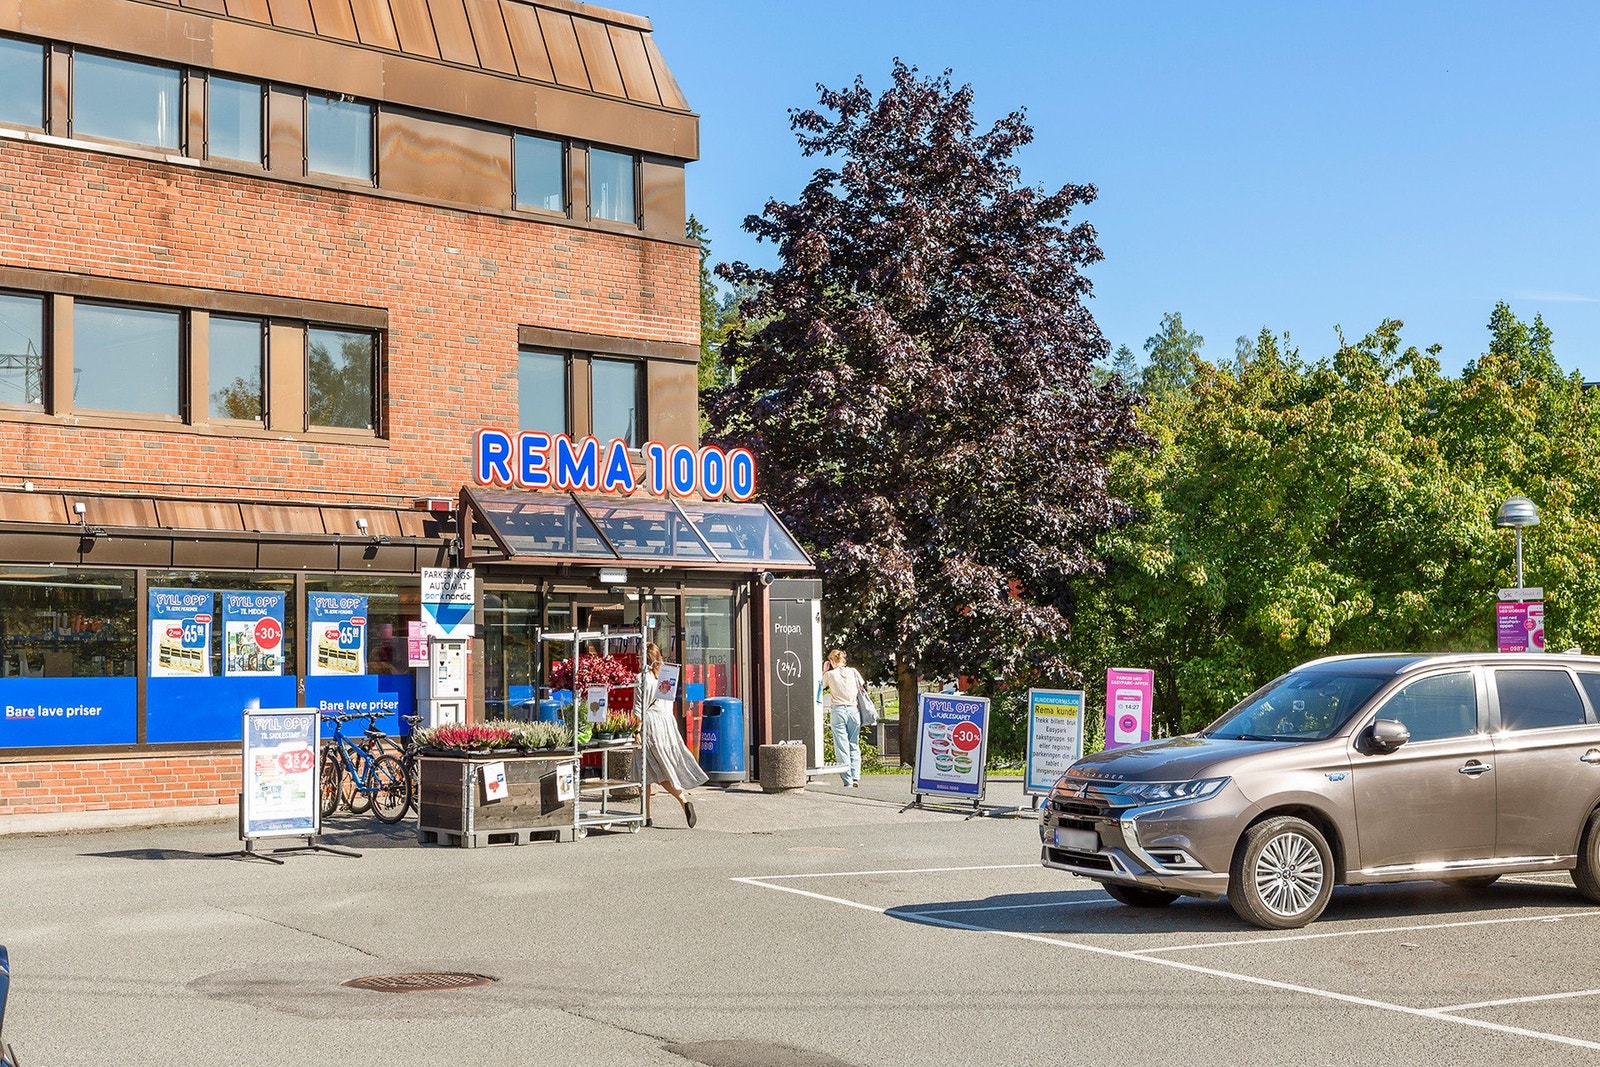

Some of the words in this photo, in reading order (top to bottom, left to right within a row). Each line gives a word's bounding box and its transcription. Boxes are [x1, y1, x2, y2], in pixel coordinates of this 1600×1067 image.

[473, 428, 637, 493] REMA
[643, 440, 756, 502] 1000
[423, 570, 473, 579] PARKERINGS-
[429, 582, 467, 591] AUTOMAT
[156, 594, 182, 605] FYLL
[183, 594, 207, 605] OPP
[229, 595, 253, 607] FYLL
[255, 596, 278, 607] OPP
[315, 597, 339, 608] FYLL
[168, 629, 174, 637] 2
[184, 625, 197, 642] 65
[255, 628, 281, 639] -30%
[774, 623, 802, 635] Propan
[341, 627, 353, 644] 65
[781, 662, 797, 676] 24/7
[5, 705, 35, 717] Bare
[38, 705, 63, 716] lave
[66, 704, 102, 718] priser
[320, 700, 344, 710] Bare
[346, 700, 366, 710] lave
[369, 699, 399, 713] priser
[929, 700, 954, 712] FYLL
[955, 703, 980, 714] OPP
[1034, 705, 1054, 714] Rema
[936, 712, 971, 720] KJØLESKAPET
[253, 718, 282, 731] FYLL
[283, 717, 310, 730] OPP
[954, 730, 980, 742] -30%
[1046, 726, 1067, 735] Easypark
[284, 754, 293, 769] 3
[301, 753, 310, 769] 2
[1033, 751, 1061, 760] parkeringen
